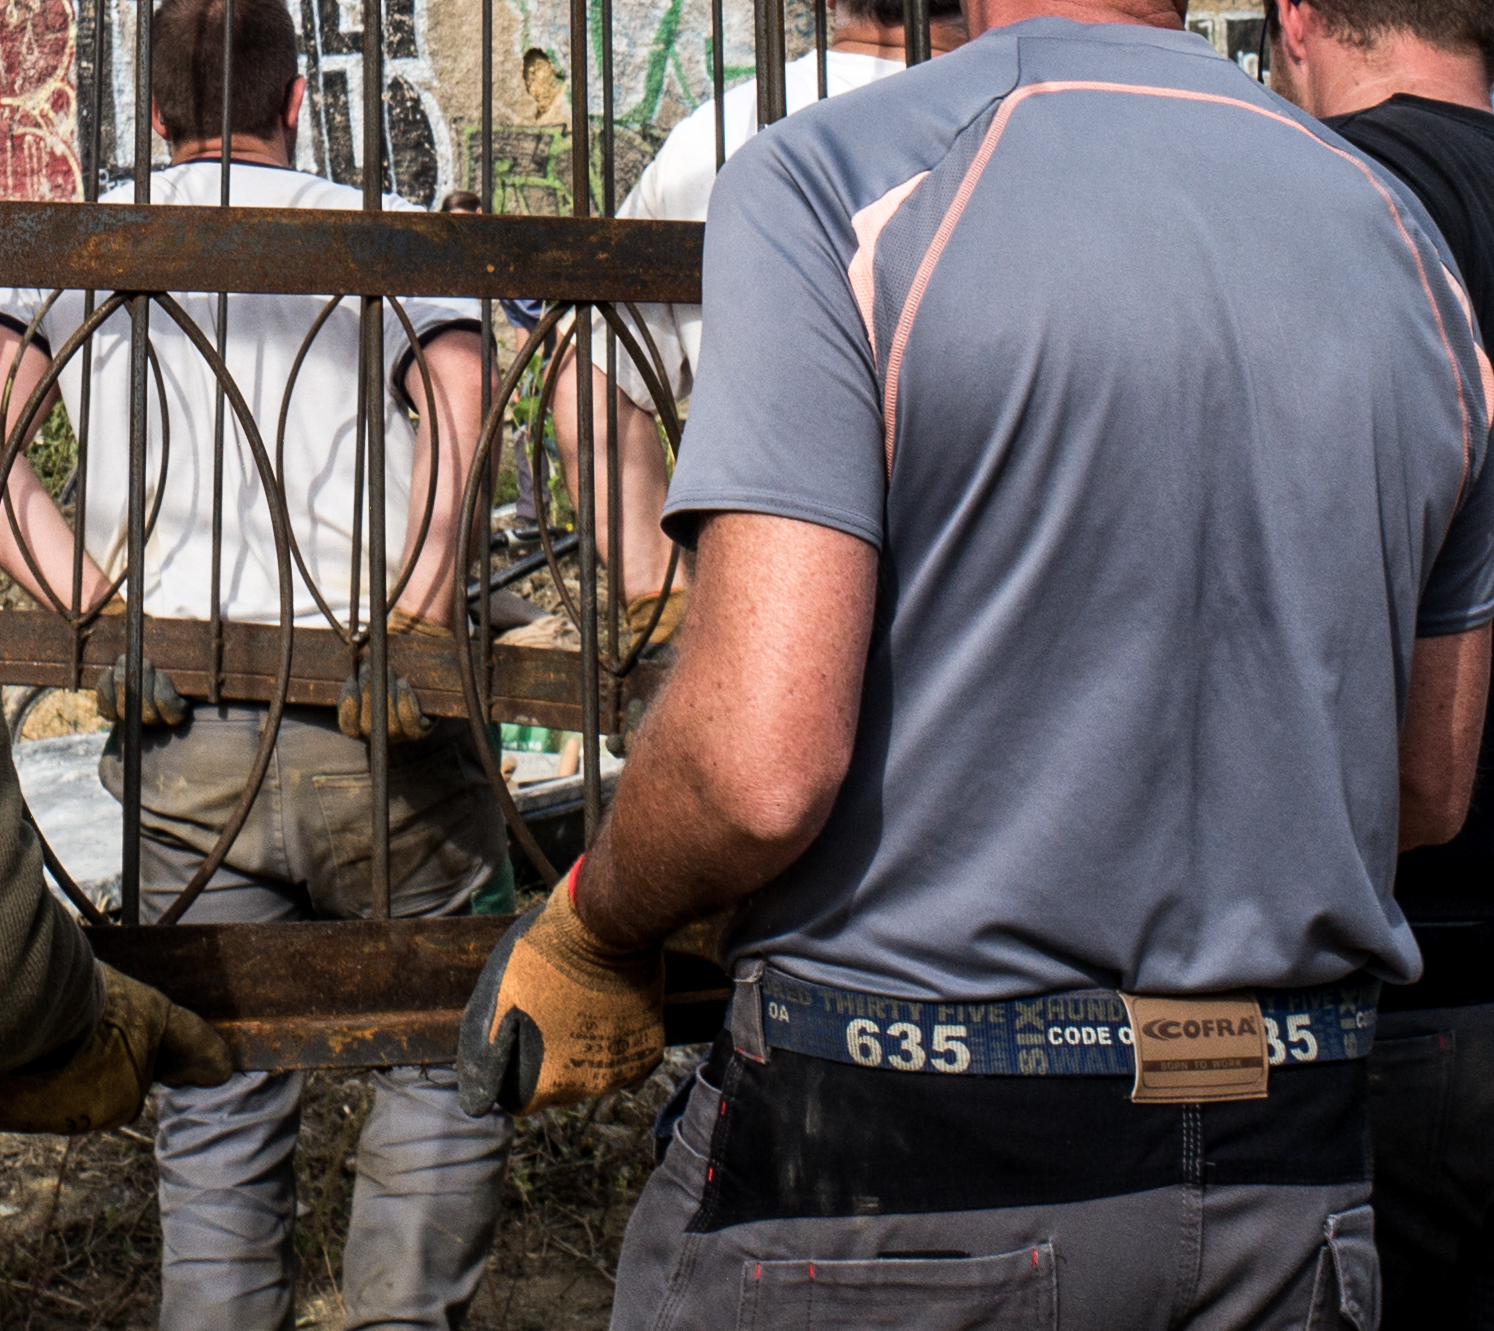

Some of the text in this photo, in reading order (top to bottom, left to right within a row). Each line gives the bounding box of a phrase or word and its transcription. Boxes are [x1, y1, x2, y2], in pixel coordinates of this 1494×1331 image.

[938, 1000, 1006, 1024] FIVE
[1048, 1026, 1111, 1045] CODE
[1157, 1018, 1257, 1039] COFRA
[846, 1018, 971, 1074] 635
[1161, 1059, 1243, 1071] BORN TO WORK
